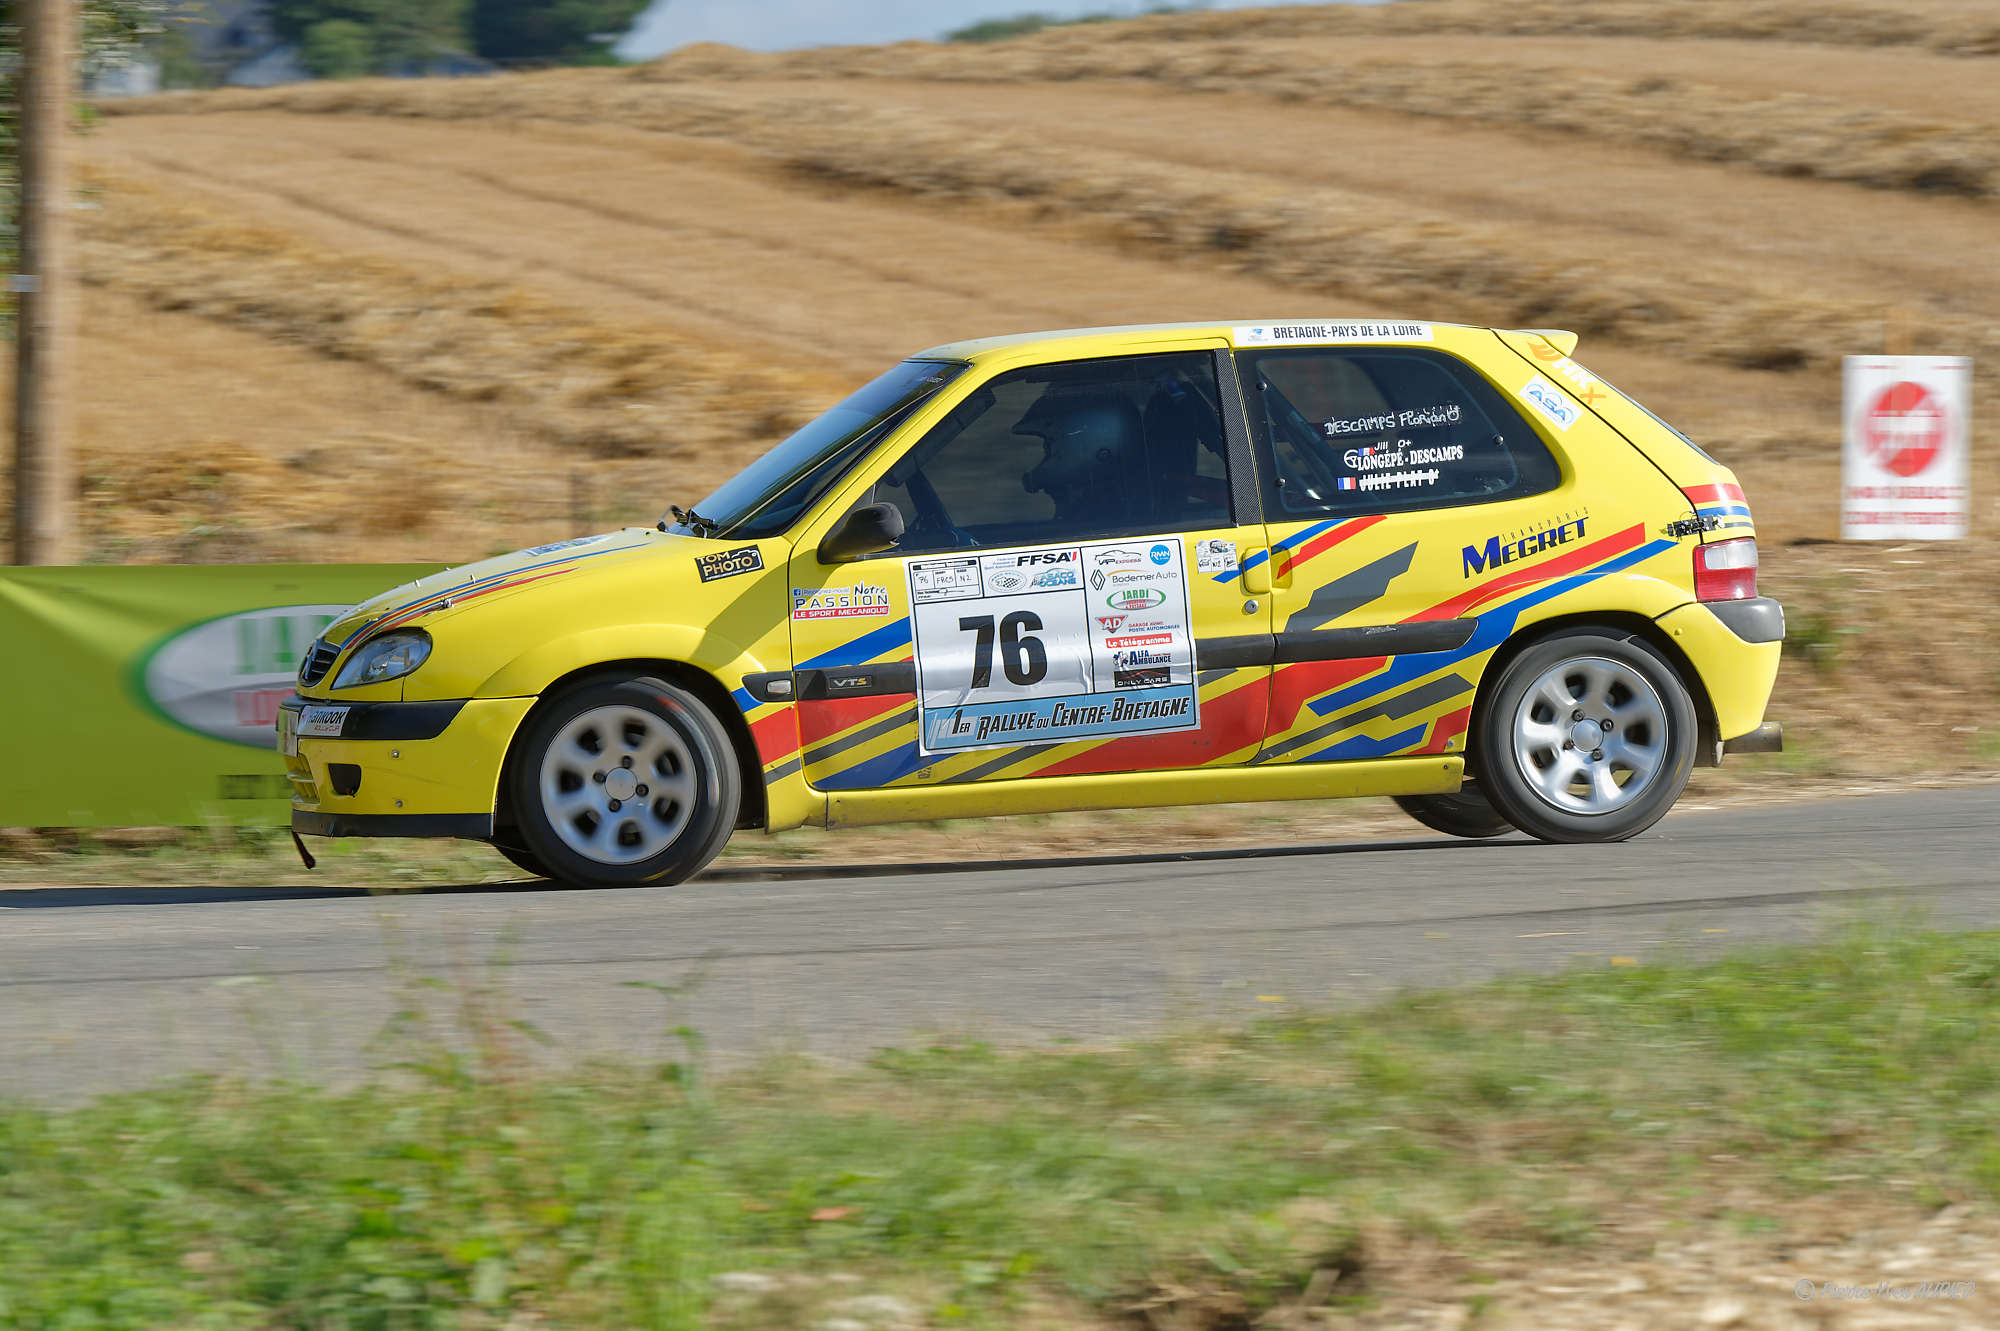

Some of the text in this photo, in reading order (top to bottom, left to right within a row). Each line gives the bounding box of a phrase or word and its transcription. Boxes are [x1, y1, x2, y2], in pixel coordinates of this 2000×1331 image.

[1273, 325, 1423, 339] BRETAGNE-PAYS DE LA LOIRE
[1324, 412, 1396, 435] DESCAMPS
[1410, 445, 1464, 465] DESCAMPS
[1462, 516, 1589, 579] MEGRET
[696, 551, 730, 565] TOM
[1017, 552, 1071, 567] FFSA
[1151, 551, 1170, 561] RMN
[703, 556, 753, 577] PHOTO
[854, 581, 886, 596] Notre
[1122, 588, 1150, 600] JARDI
[796, 595, 888, 610] PASSION
[808, 609, 836, 617] SPORT
[838, 607, 888, 616] MECANIQUE
[1104, 618, 1121, 629] AD
[958, 610, 1048, 689] 76
[1107, 637, 1171, 648] Le Télégramme
[833, 677, 867, 687] VTS
[976, 711, 1037, 741] RALLYE
[1036, 718, 1049, 729] DU
[1050, 696, 1190, 728] CENTRE-BRETAGNE
